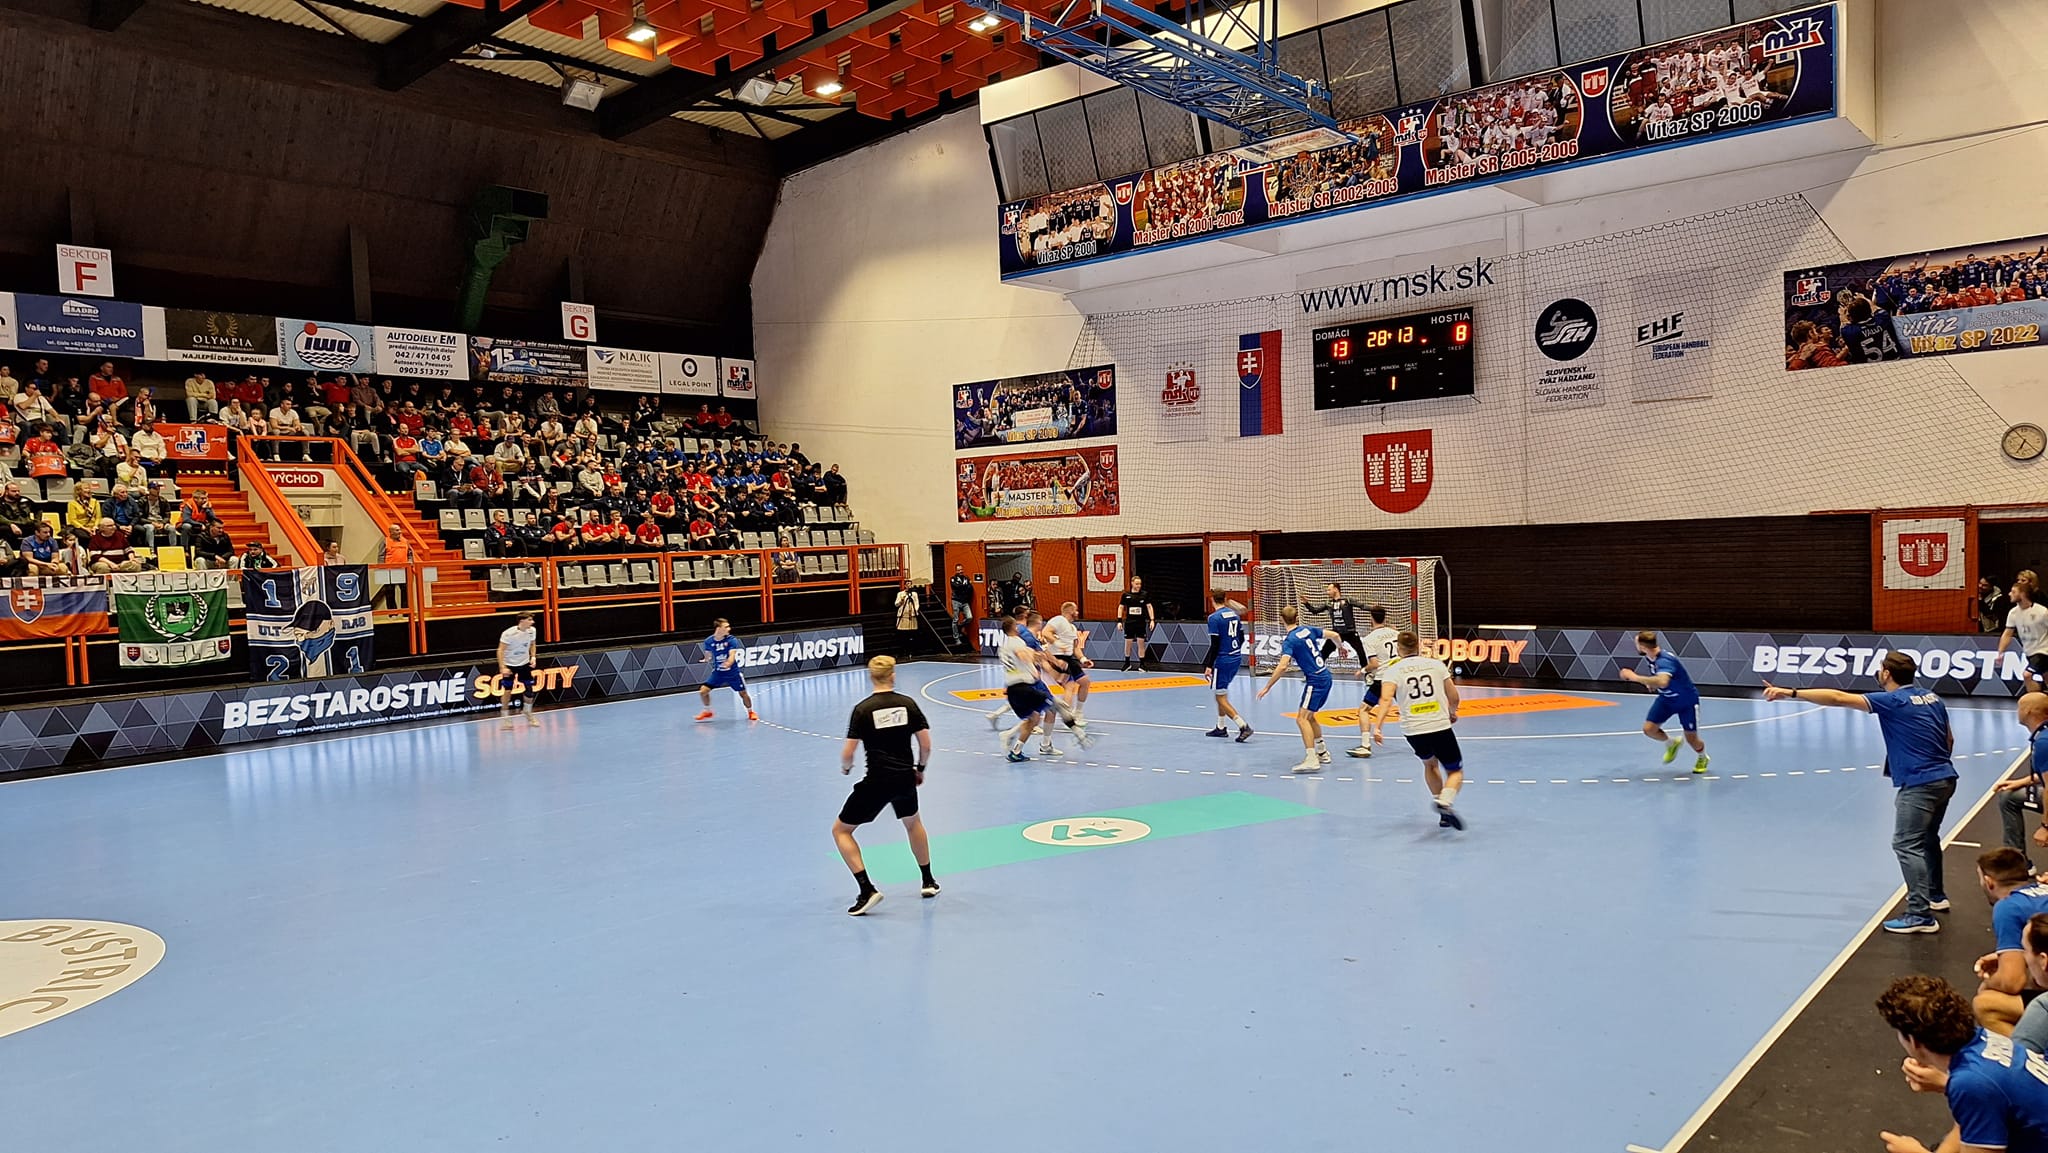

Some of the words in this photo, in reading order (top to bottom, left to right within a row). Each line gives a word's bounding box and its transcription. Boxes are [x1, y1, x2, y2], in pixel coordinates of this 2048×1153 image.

[1691, 110, 1715, 131] SP
[1718, 101, 1762, 126] 2006
[1425, 163, 1476, 186] Majster
[1478, 156, 1499, 174] SR
[1501, 139, 1579, 169] 2005-2006
[1268, 199, 1312, 218] Majster
[1314, 190, 1331, 209] SR
[1333, 177, 1399, 204] 2002-2003
[1133, 228, 1171, 245] Majster
[1172, 222, 1187, 237] SR
[1188, 210, 1245, 233] 2001-2002
[60, 247, 109, 261] SEKTOR
[1061, 245, 1073, 260] SP
[1074, 240, 1097, 257] 2001
[75, 261, 97, 291] F
[1301, 257, 1494, 313] www.msk.sk
[564, 303, 593, 313] SEKTOR
[570, 315, 589, 338] G
[1431, 312, 1470, 324] HOSTIA
[1638, 312, 1684, 342] EHF
[48, 325, 95, 336] stavebniny
[96, 327, 137, 338] SADRO
[193, 334, 253, 348] OLYMPIA
[387, 332, 437, 344] AUTODIELY
[440, 335, 456, 345] EM
[1315, 328, 1350, 341] DOMÁCI
[1456, 325, 1467, 341] 8
[1960, 329, 1987, 348] SP
[1990, 323, 2040, 345] 2022
[1333, 341, 1348, 357] 13
[1860, 330, 1898, 362] 54
[416, 352, 429, 360] 471
[442, 354, 451, 362] 05
[491, 347, 515, 371] 15
[399, 366, 418, 374] 0903
[1391, 375, 1396, 390] 1
[1562, 383, 1600, 393] HANDBALL
[1545, 392, 1589, 402] FEDERATION
[1026, 429, 1037, 440] SP
[271, 471, 319, 487] VÝCHOD
[1008, 491, 1047, 501] MAJSTER
[261, 579, 281, 608] 1
[336, 572, 360, 602] 9
[1228, 619, 1238, 637] 47
[142, 641, 218, 664] BIELE
[1420, 638, 1528, 664] SOBOTY
[265, 654, 290, 681] 2
[346, 646, 364, 673] 1
[1407, 674, 1434, 699] 33
[223, 671, 467, 730] BEZSTAROSTNÉ
